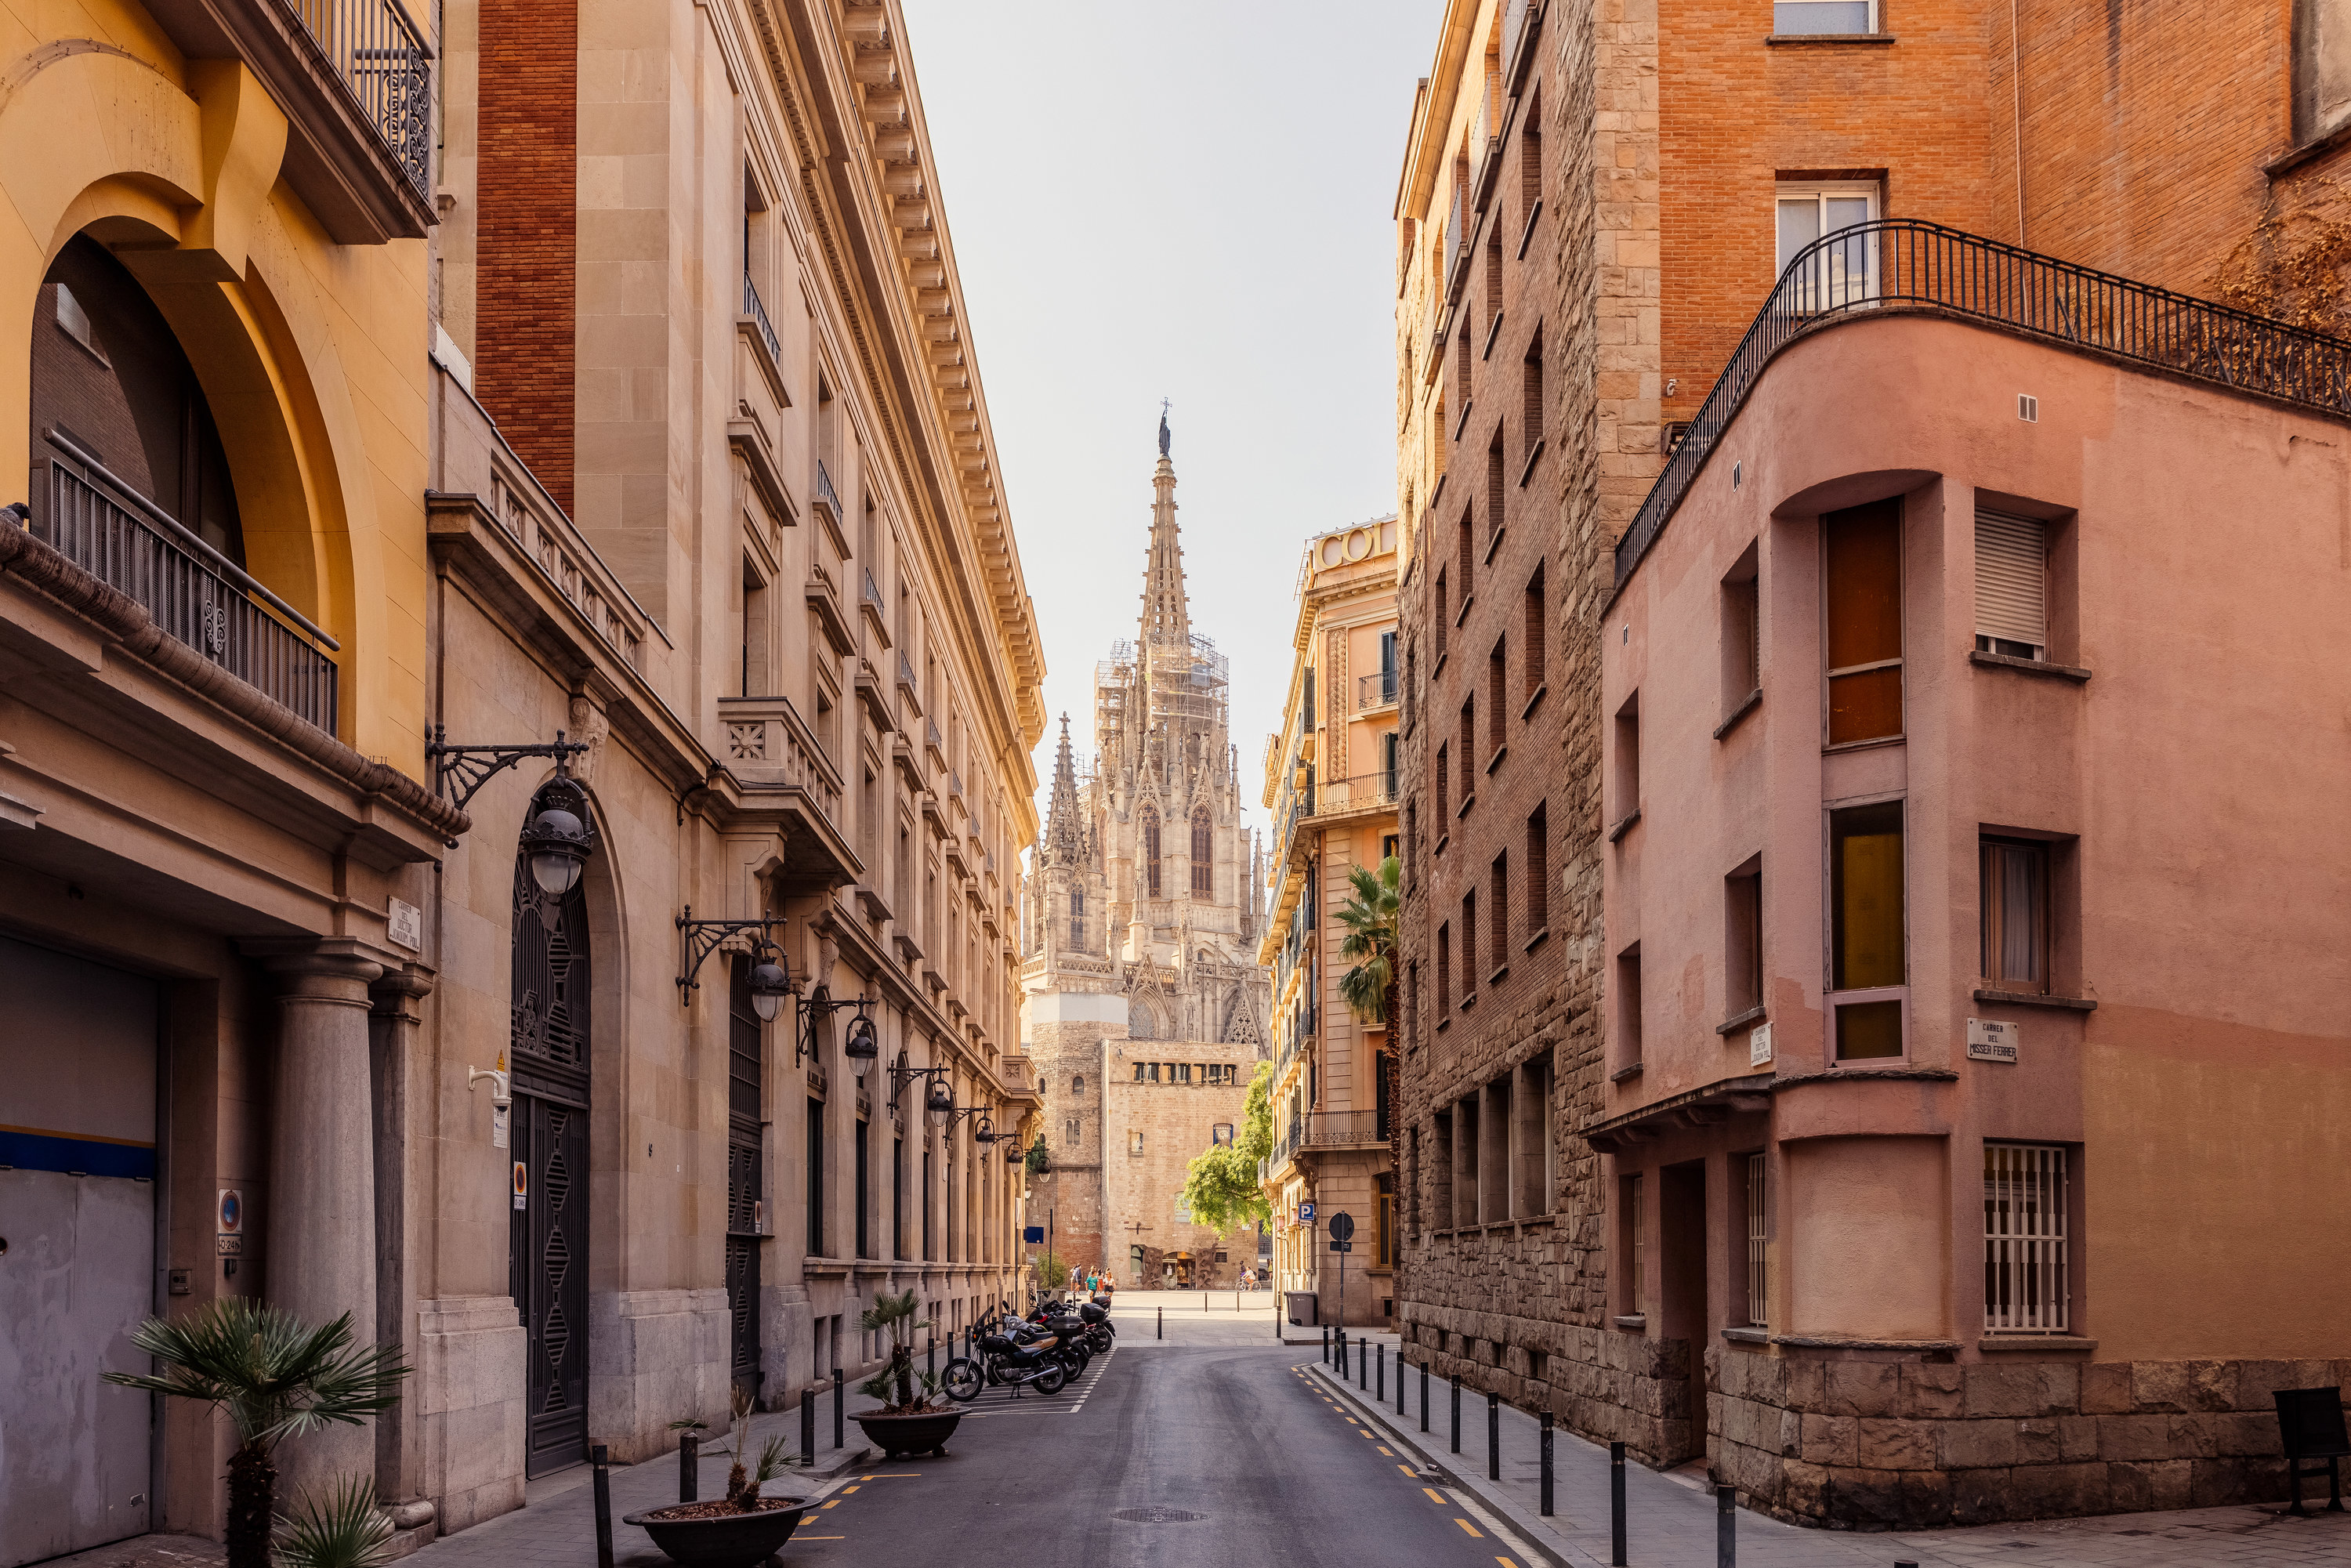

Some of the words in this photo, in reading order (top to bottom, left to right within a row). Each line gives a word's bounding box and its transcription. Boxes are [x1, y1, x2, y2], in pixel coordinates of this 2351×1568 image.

[398, 900, 411, 914] CARRER
[397, 918, 413, 935] DOCTOR
[392, 928, 408, 944] JOAQUIM
[1982, 1023, 2004, 1033] CARRER
[1969, 1043, 1991, 1055] MISSER
[1993, 1045, 2016, 1057] FERRER
[1301, 1205, 1311, 1219] P
